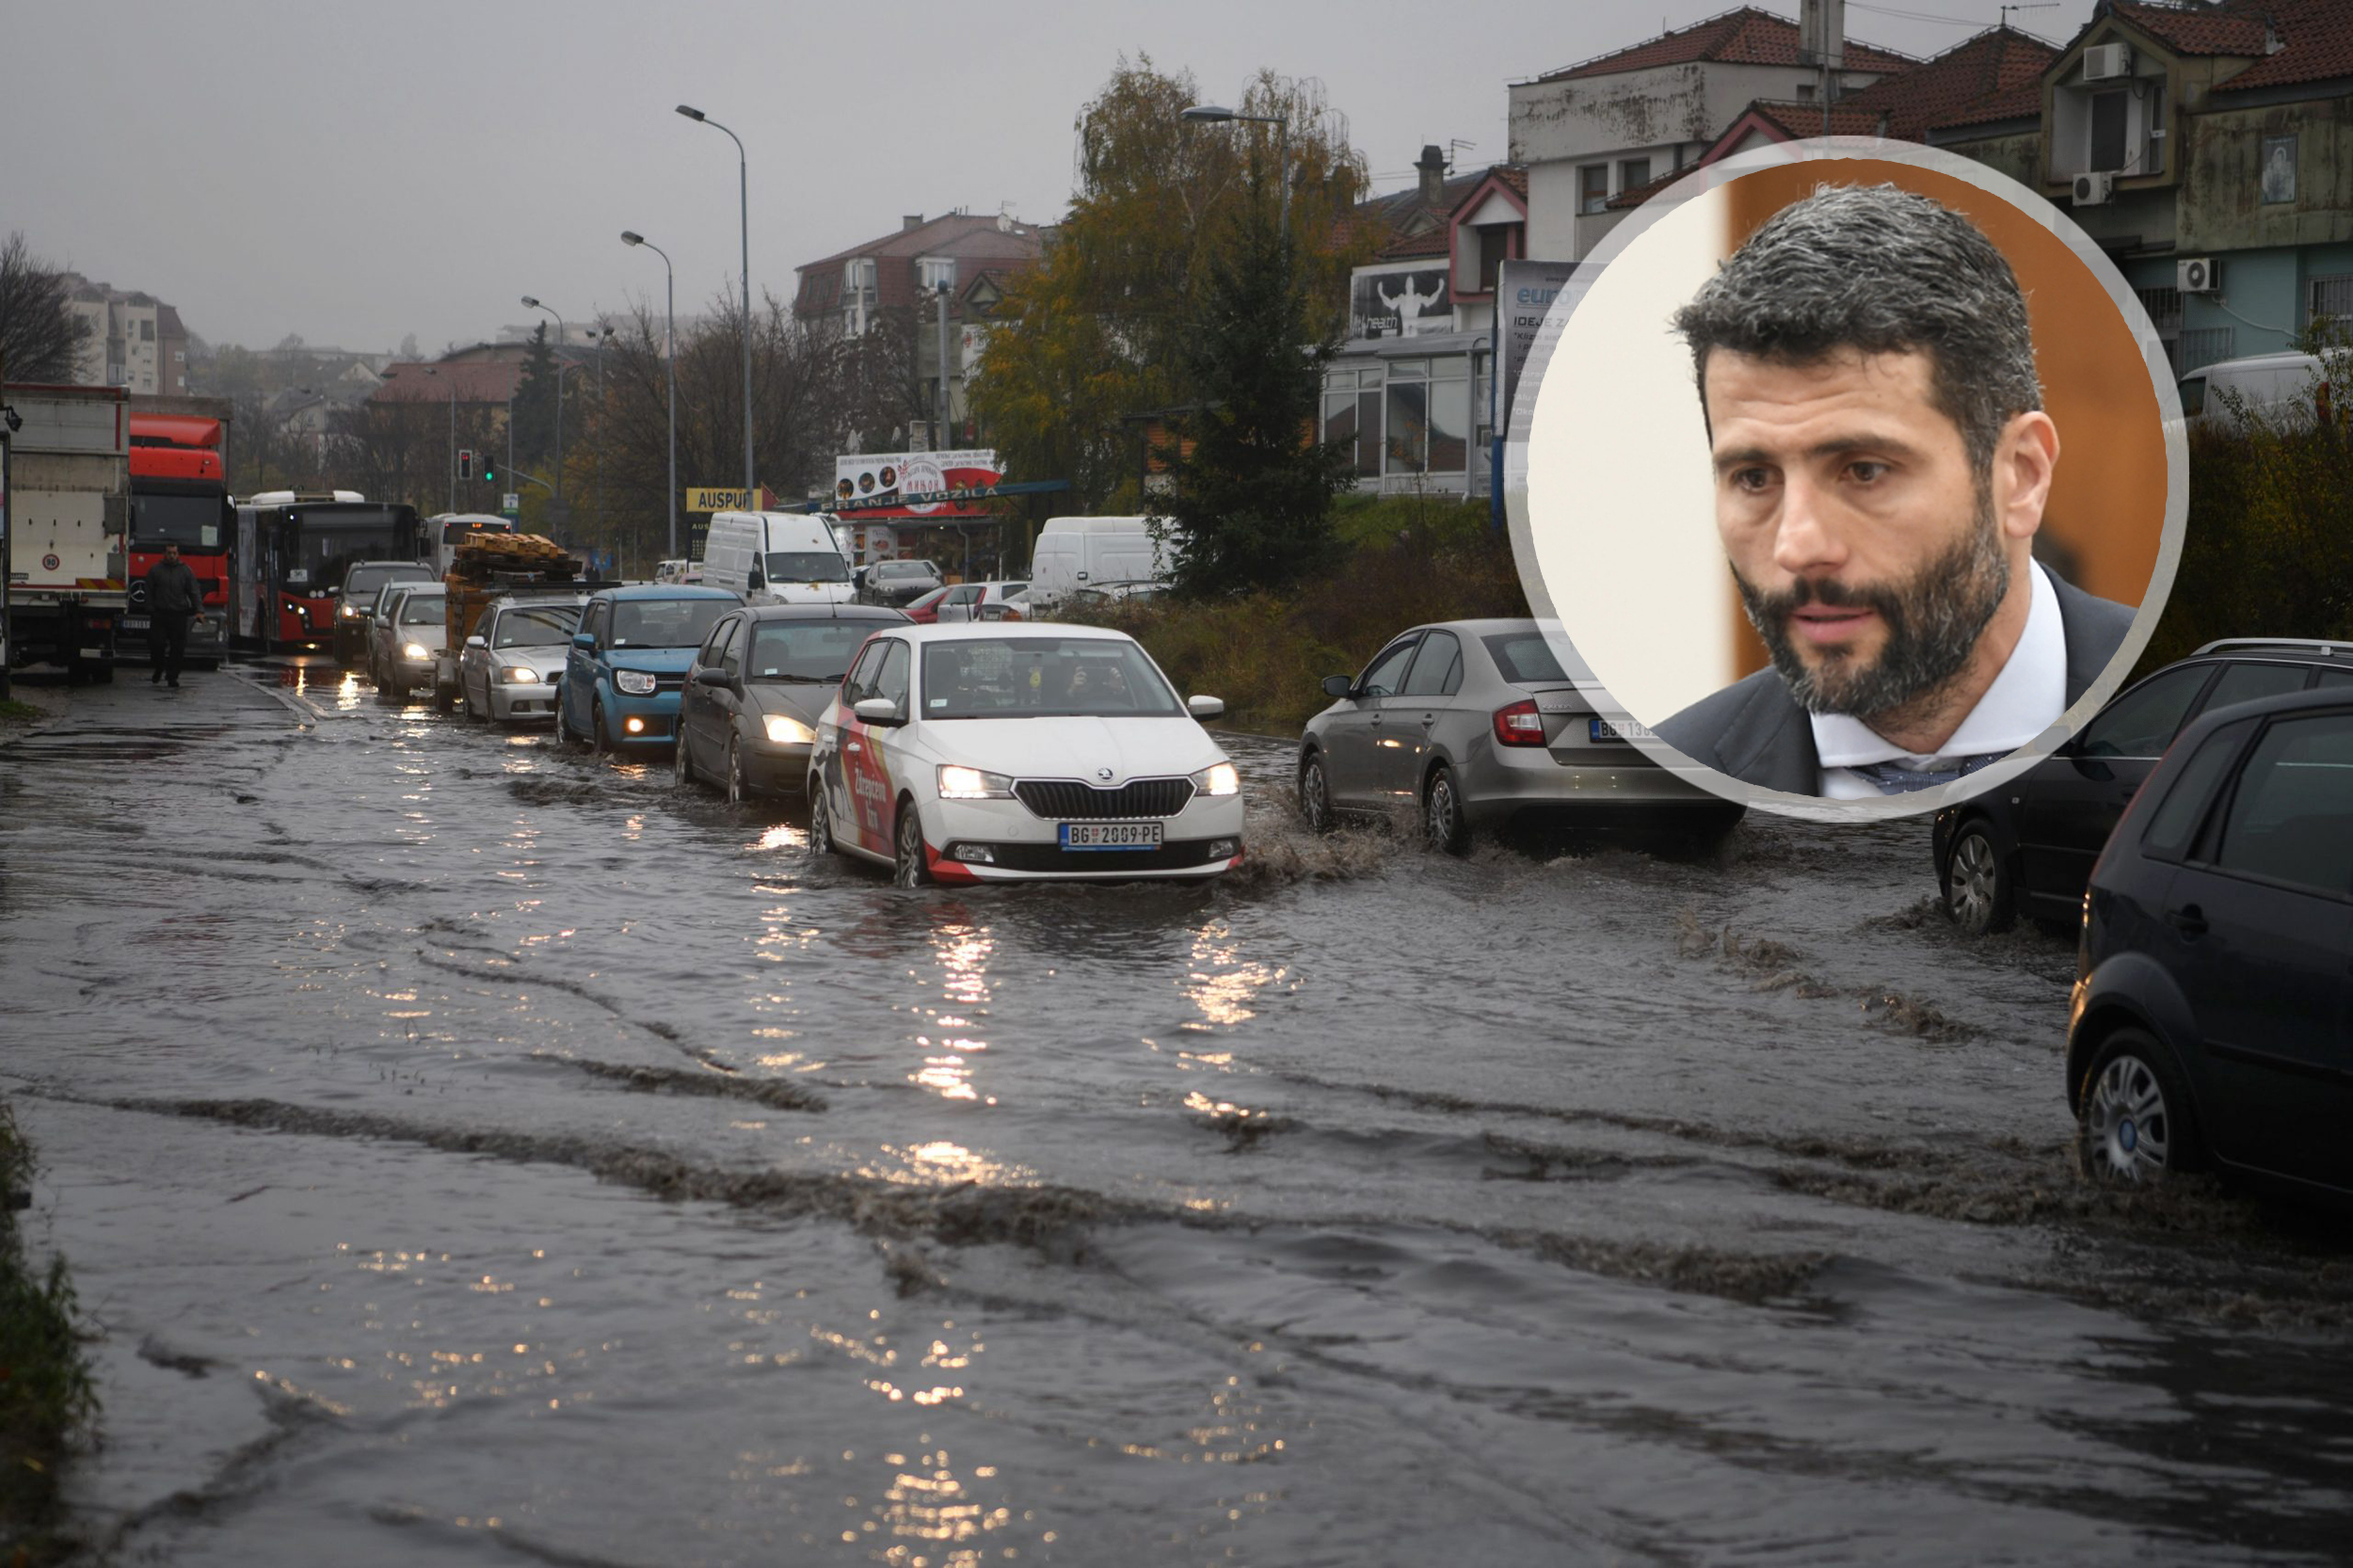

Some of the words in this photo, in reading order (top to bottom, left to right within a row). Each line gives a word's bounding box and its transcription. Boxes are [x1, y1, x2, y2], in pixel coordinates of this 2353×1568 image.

[1513, 316, 1551, 328] IDEJE
[698, 491, 752, 508] AUSPU
[821, 494, 909, 512] PRANJE
[920, 487, 999, 502] VOZILA
[1601, 722, 1617, 737] BG
[1071, 827, 1089, 843] BG
